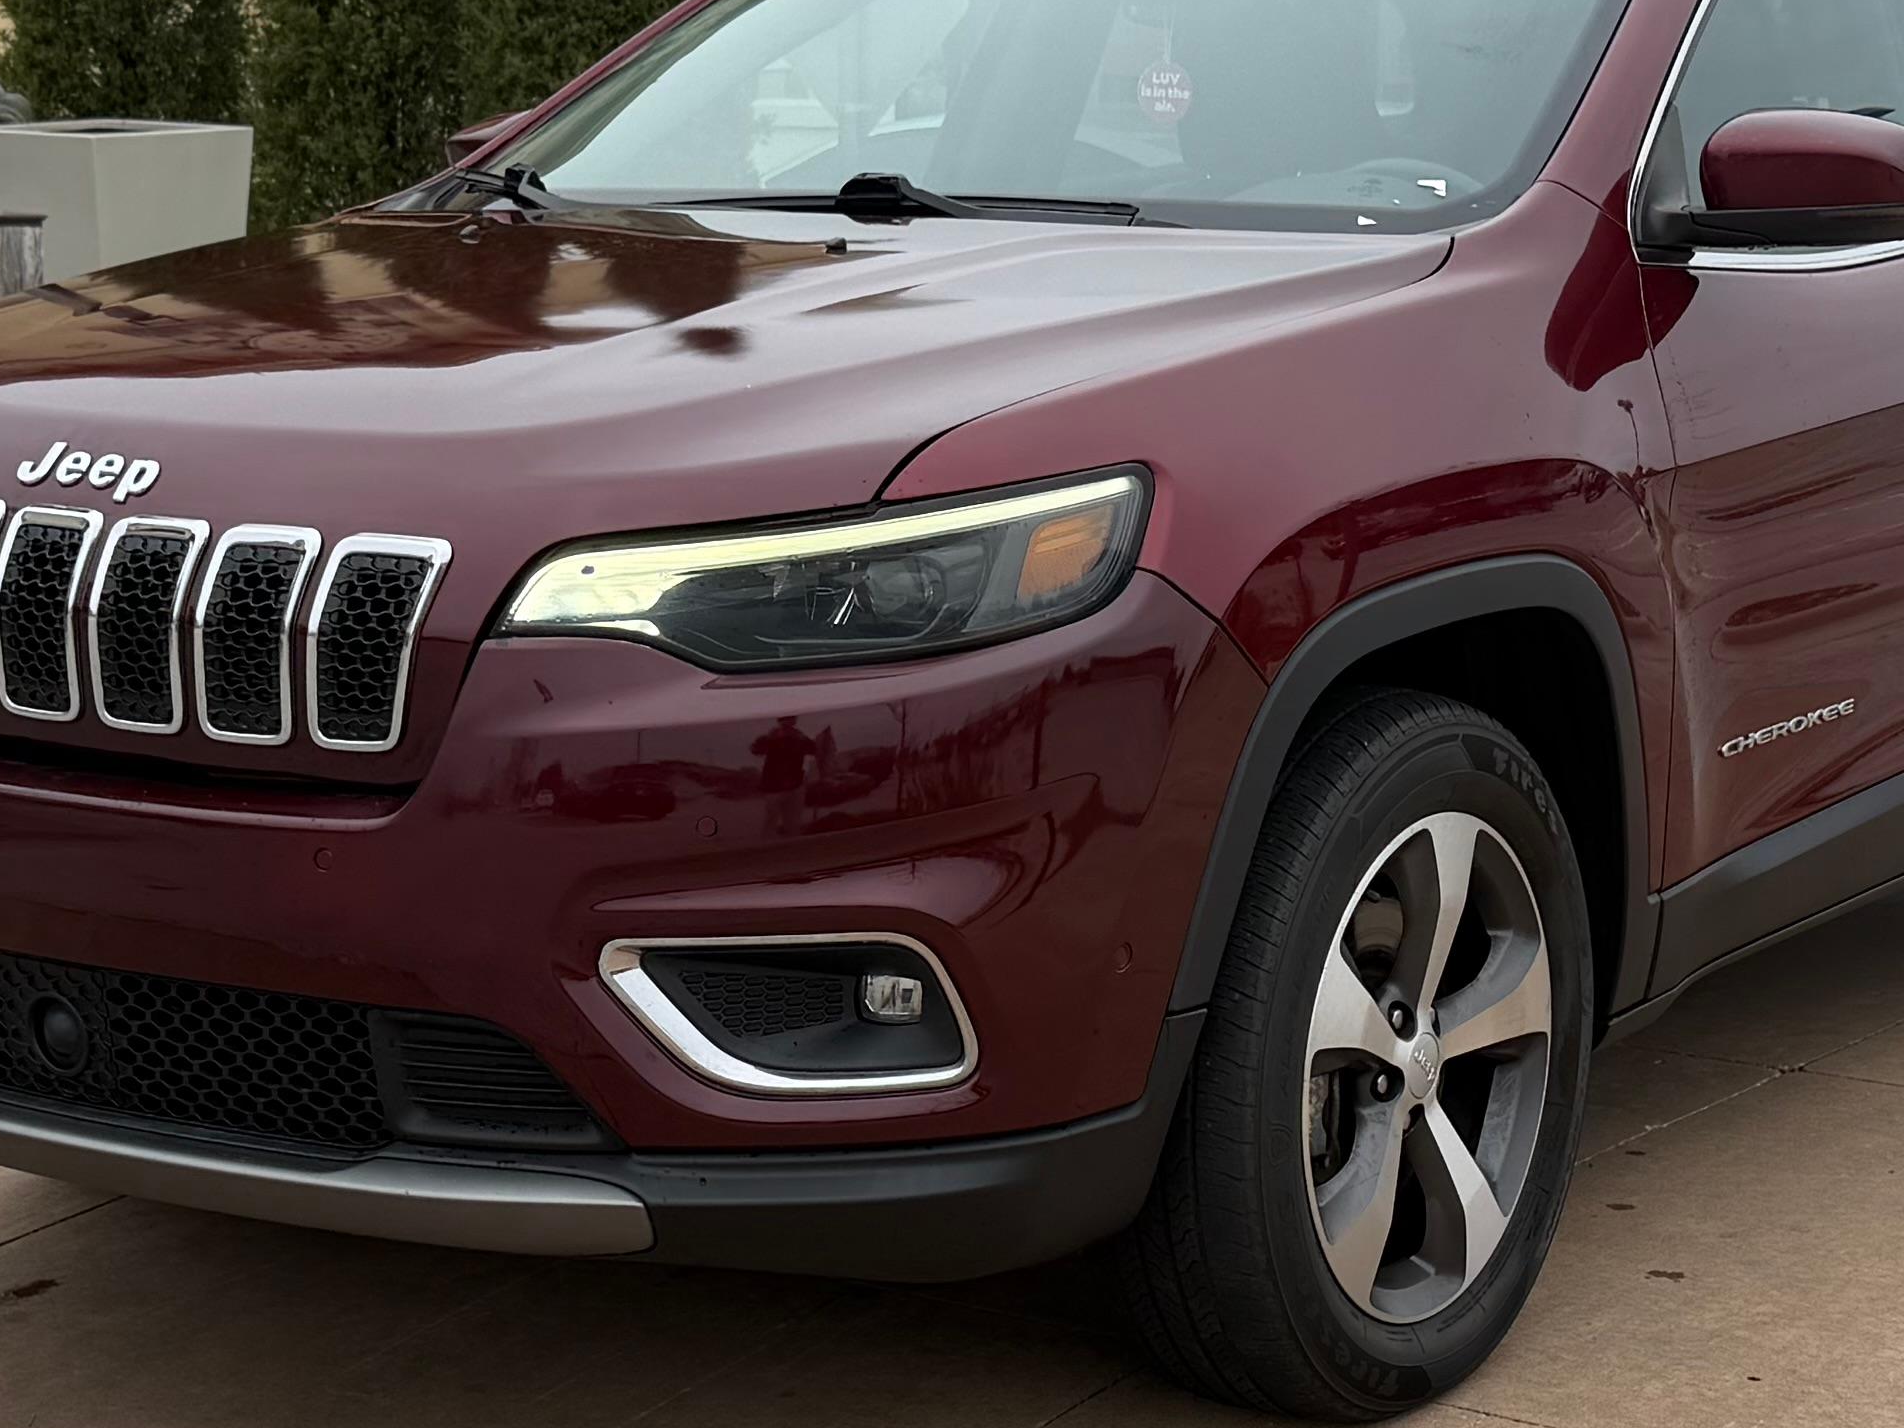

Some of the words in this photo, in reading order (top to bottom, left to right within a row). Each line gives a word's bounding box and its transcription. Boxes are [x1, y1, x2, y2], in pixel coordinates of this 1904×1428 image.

[1152, 72, 1181, 84] LUV
[16, 441, 161, 504] Jeep
[1718, 698, 1855, 758] CHEROKEE
